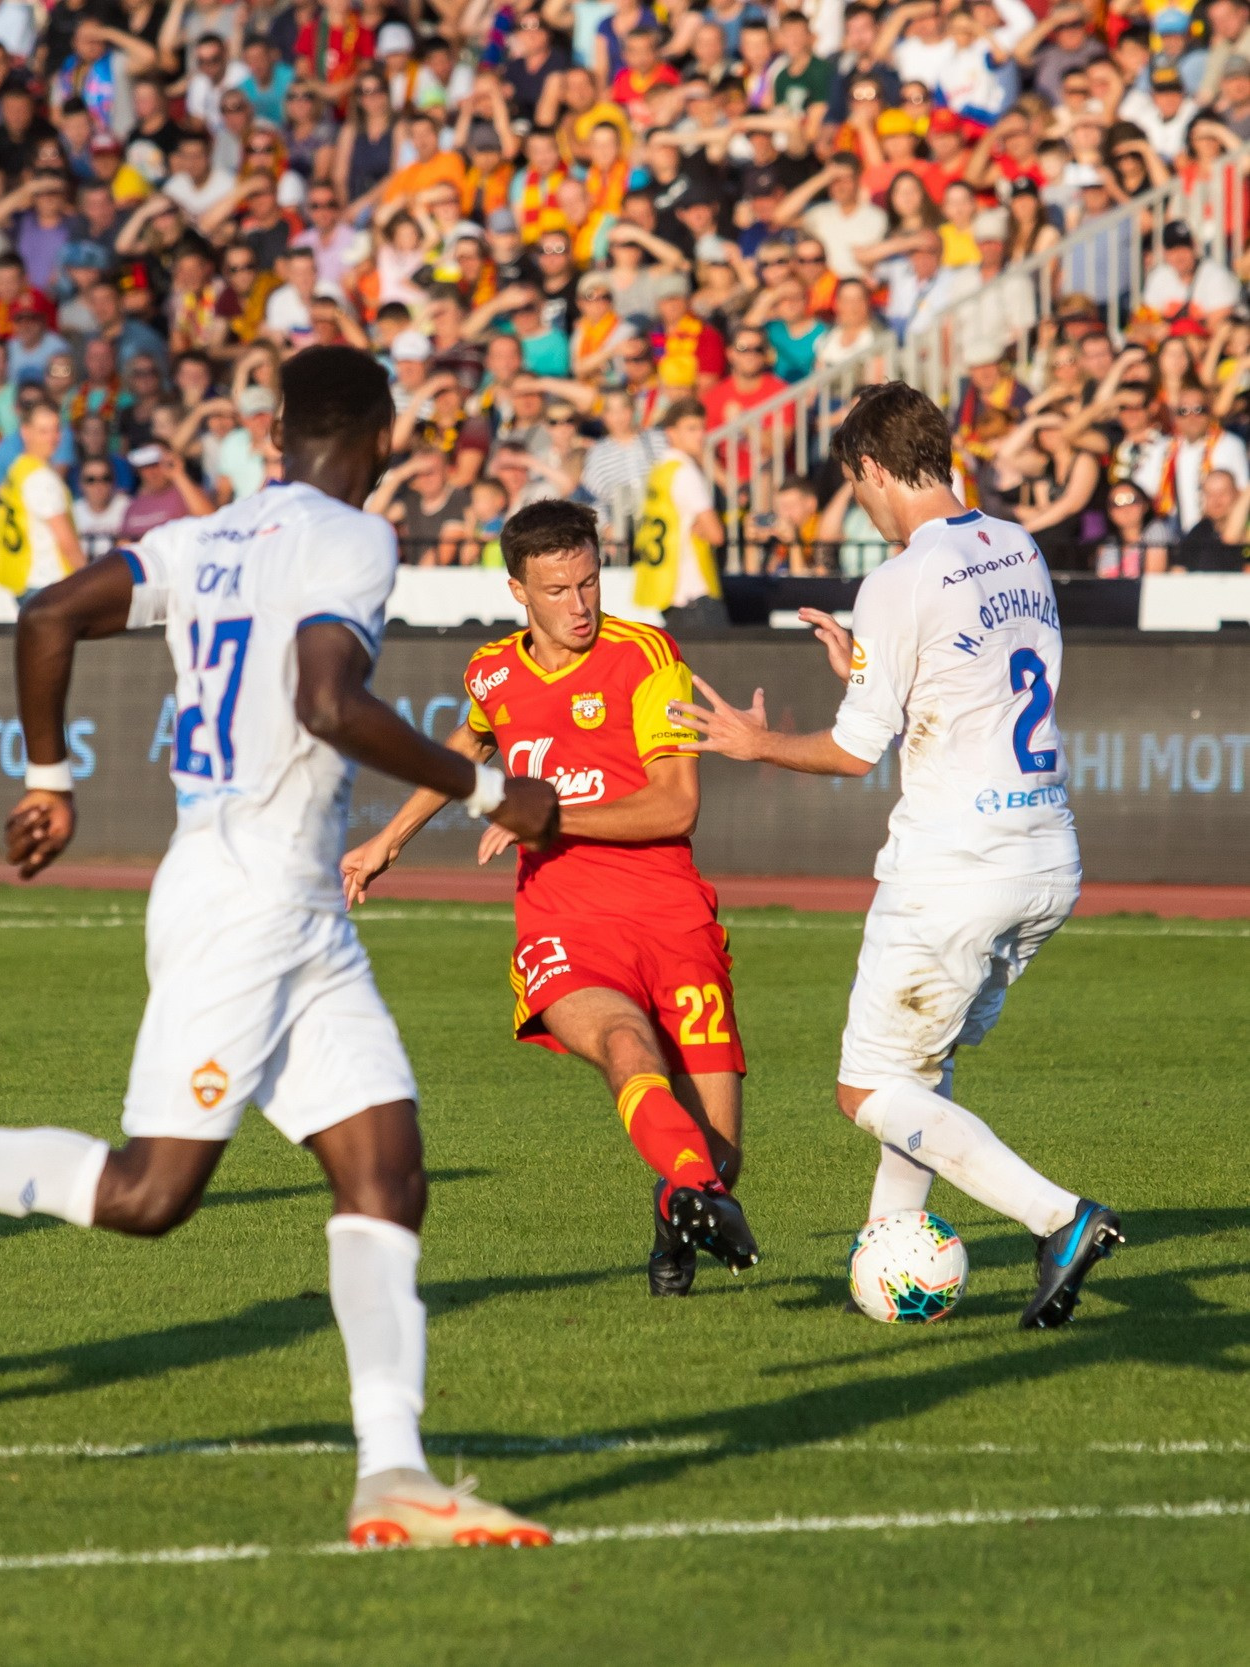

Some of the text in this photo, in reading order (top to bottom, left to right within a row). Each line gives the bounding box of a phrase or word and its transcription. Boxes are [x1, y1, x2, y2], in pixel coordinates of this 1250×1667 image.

[942, 551, 1025, 590] АЭРОФЛОТ
[1009, 647, 1057, 775] 2
[675, 983, 731, 1045] 22
